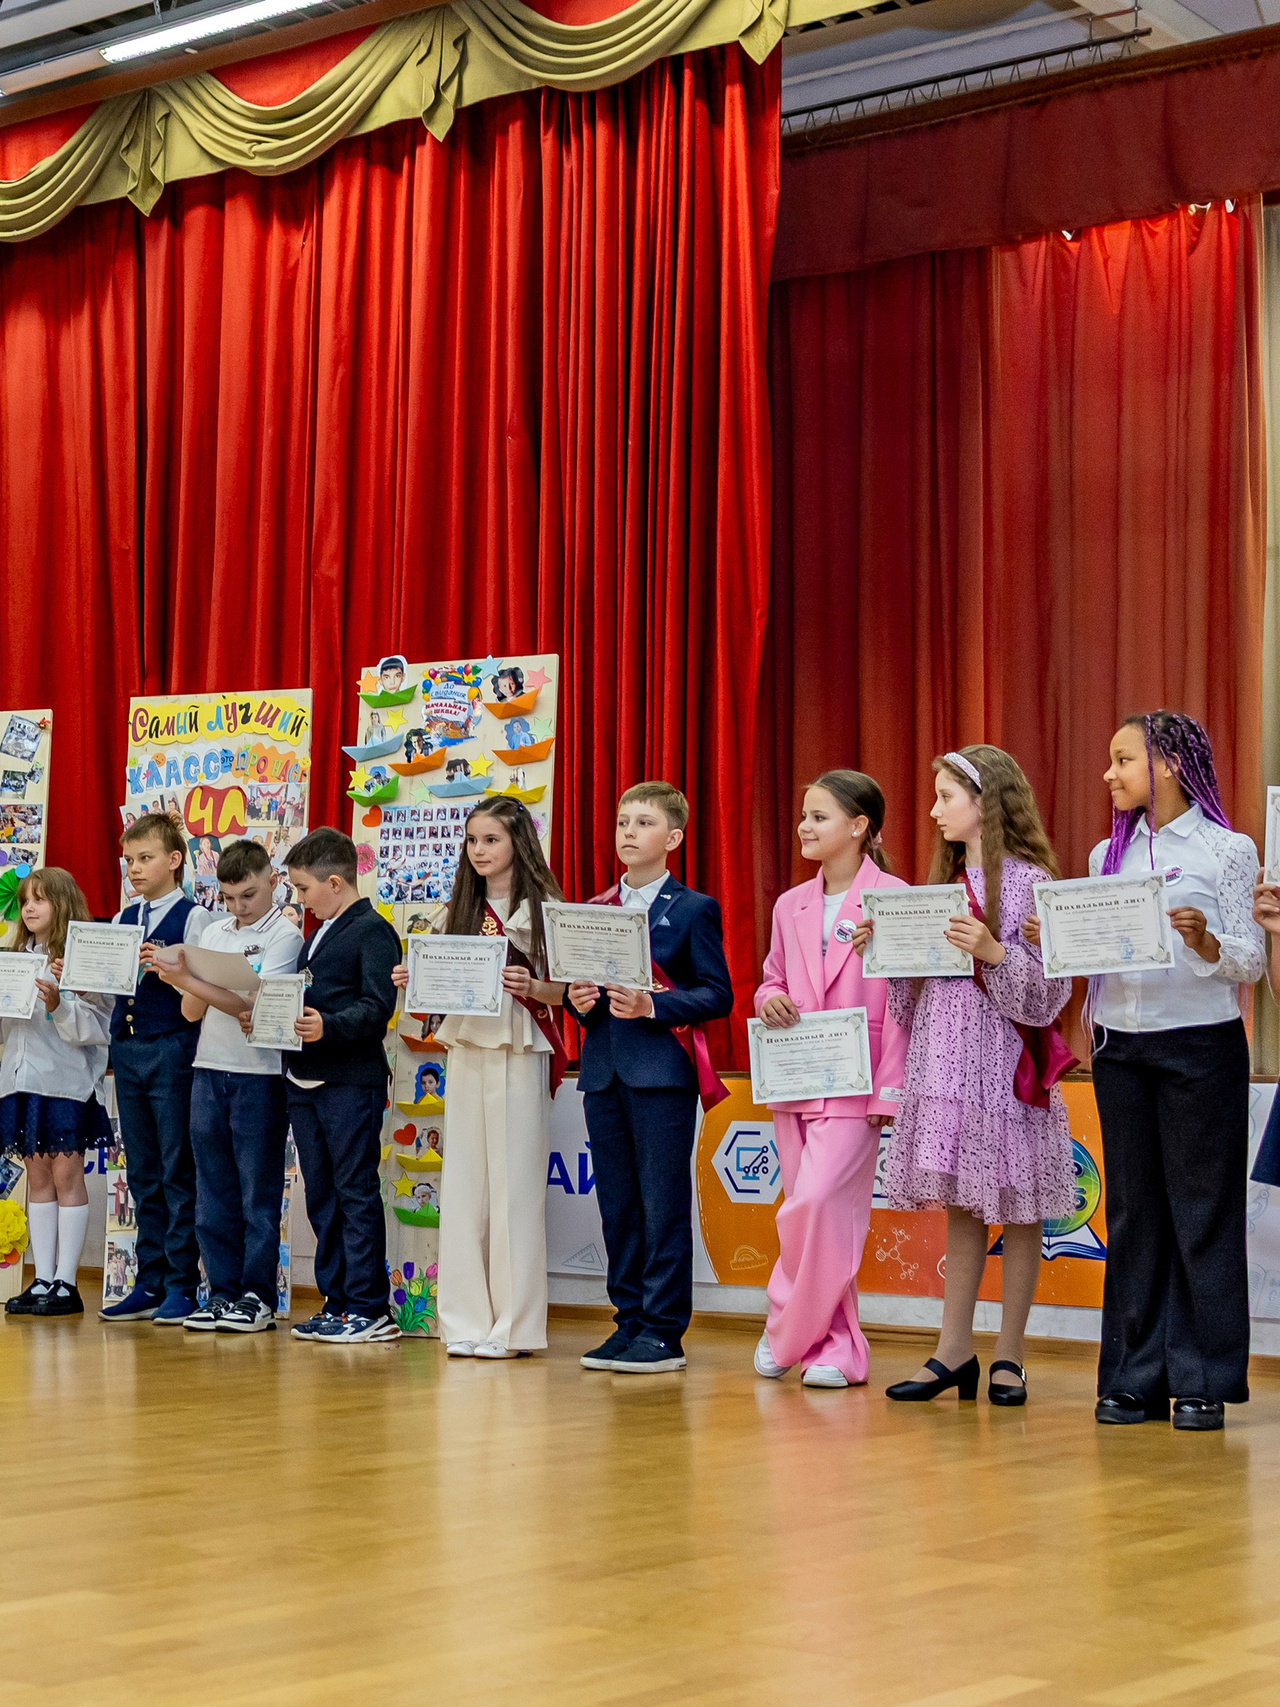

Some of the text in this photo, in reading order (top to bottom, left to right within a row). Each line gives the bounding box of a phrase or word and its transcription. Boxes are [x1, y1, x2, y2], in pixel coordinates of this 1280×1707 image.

[131, 704, 200, 742] Самый
[425, 702, 468, 712] НАЧАЛЬНАЯ
[129, 749, 221, 795] КЛАСС
[235, 749, 269, 777] ПРО
